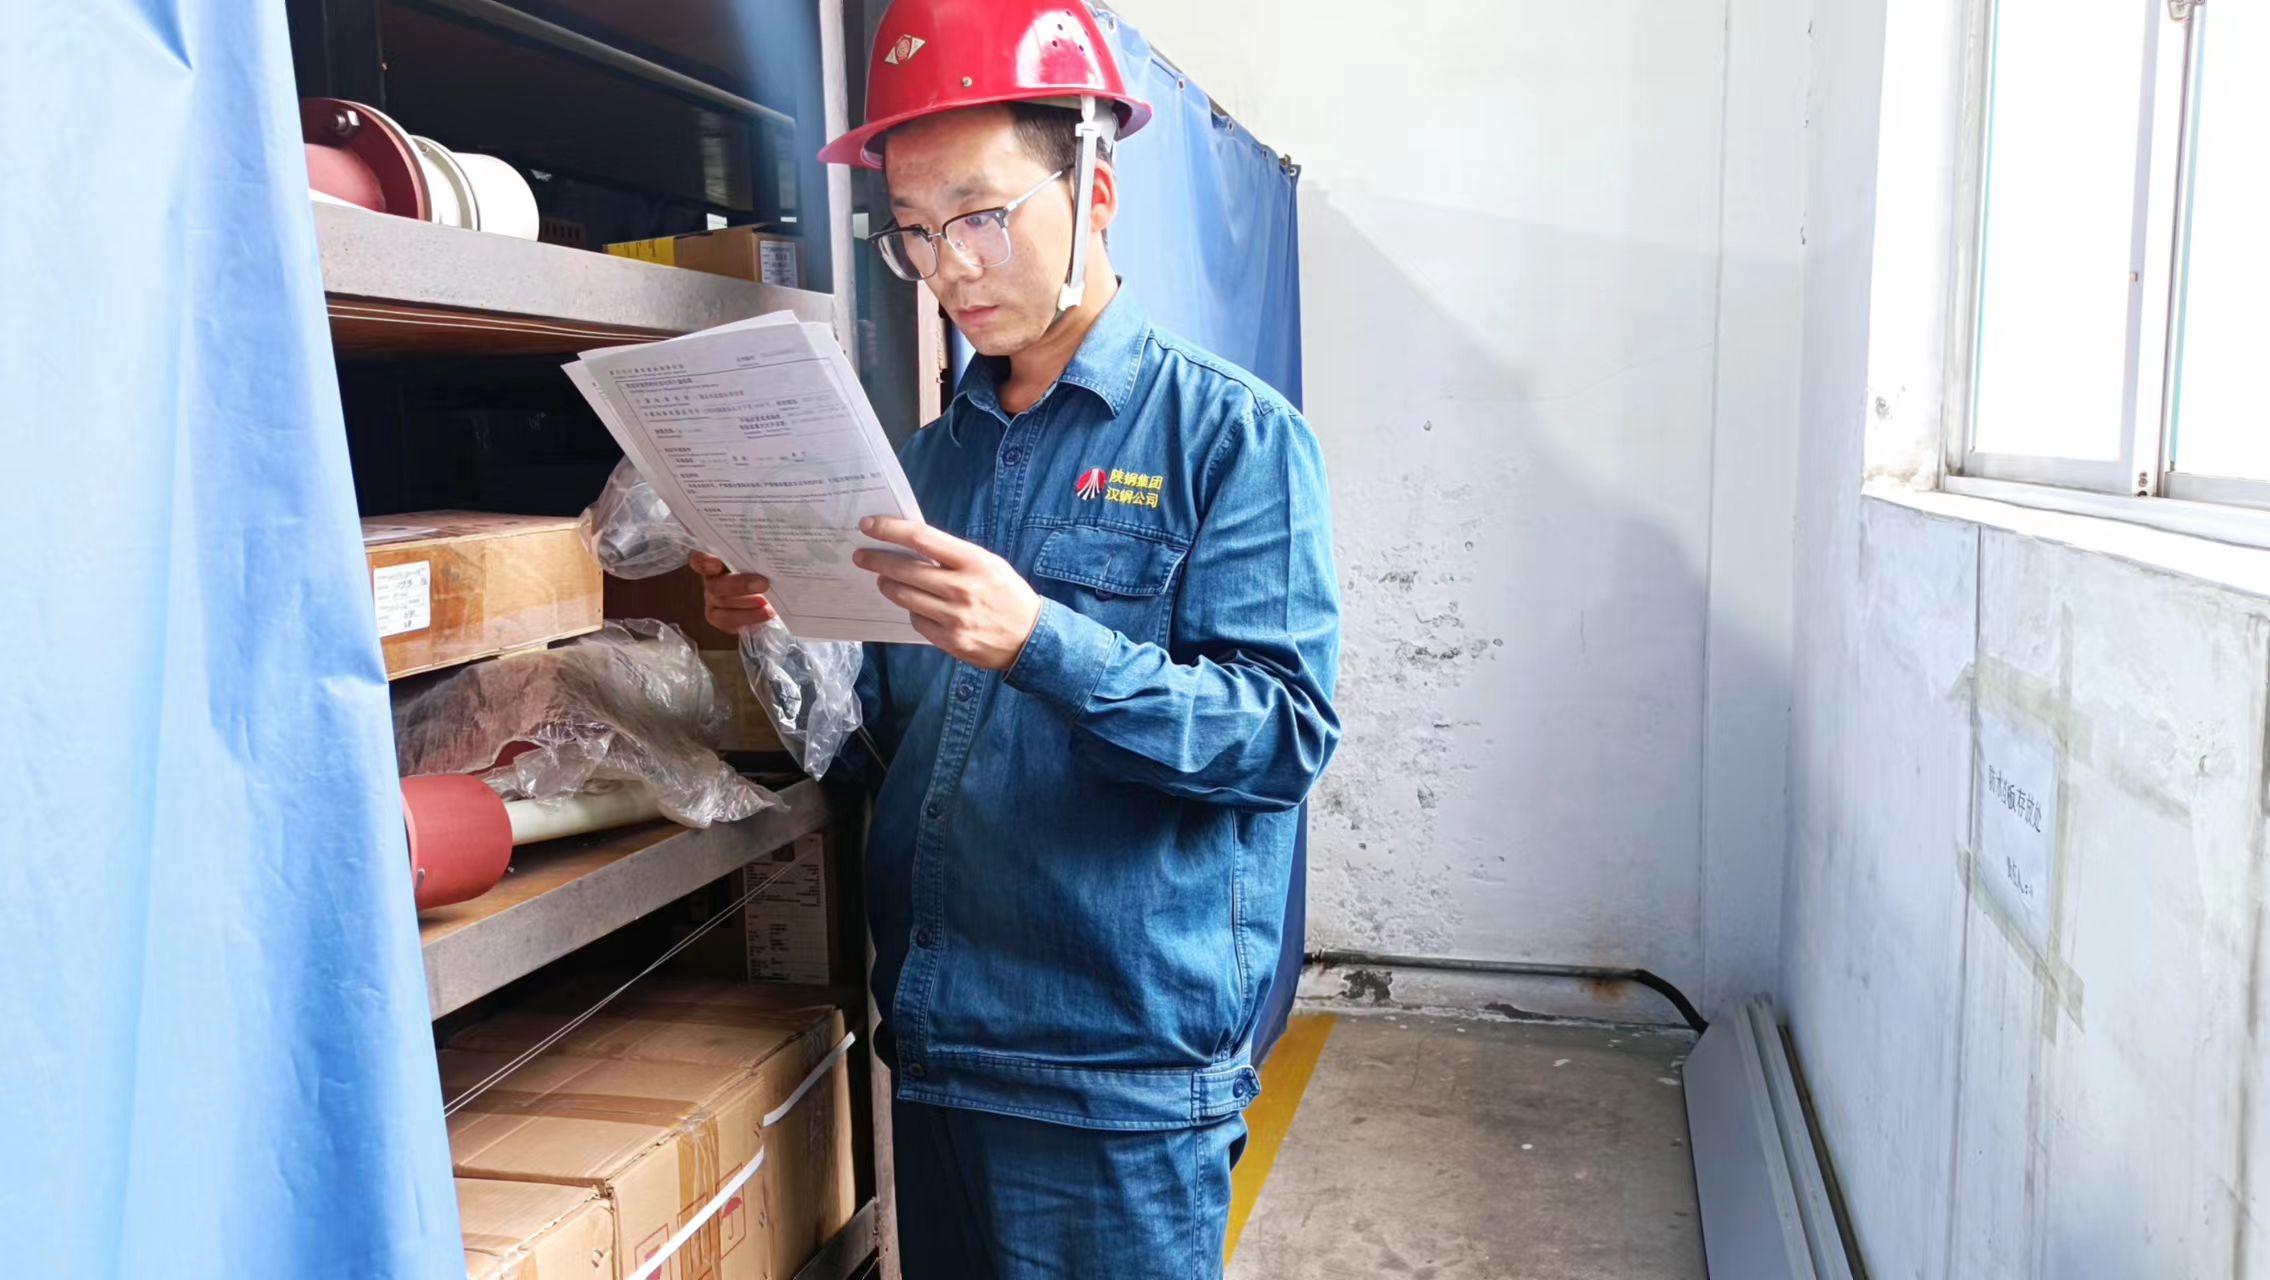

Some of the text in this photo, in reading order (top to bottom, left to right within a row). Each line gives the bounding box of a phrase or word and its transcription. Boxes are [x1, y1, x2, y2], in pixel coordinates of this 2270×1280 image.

[1109, 469, 1163, 490] 陕钢集团
[1105, 486, 1159, 508] 汉钢公司
